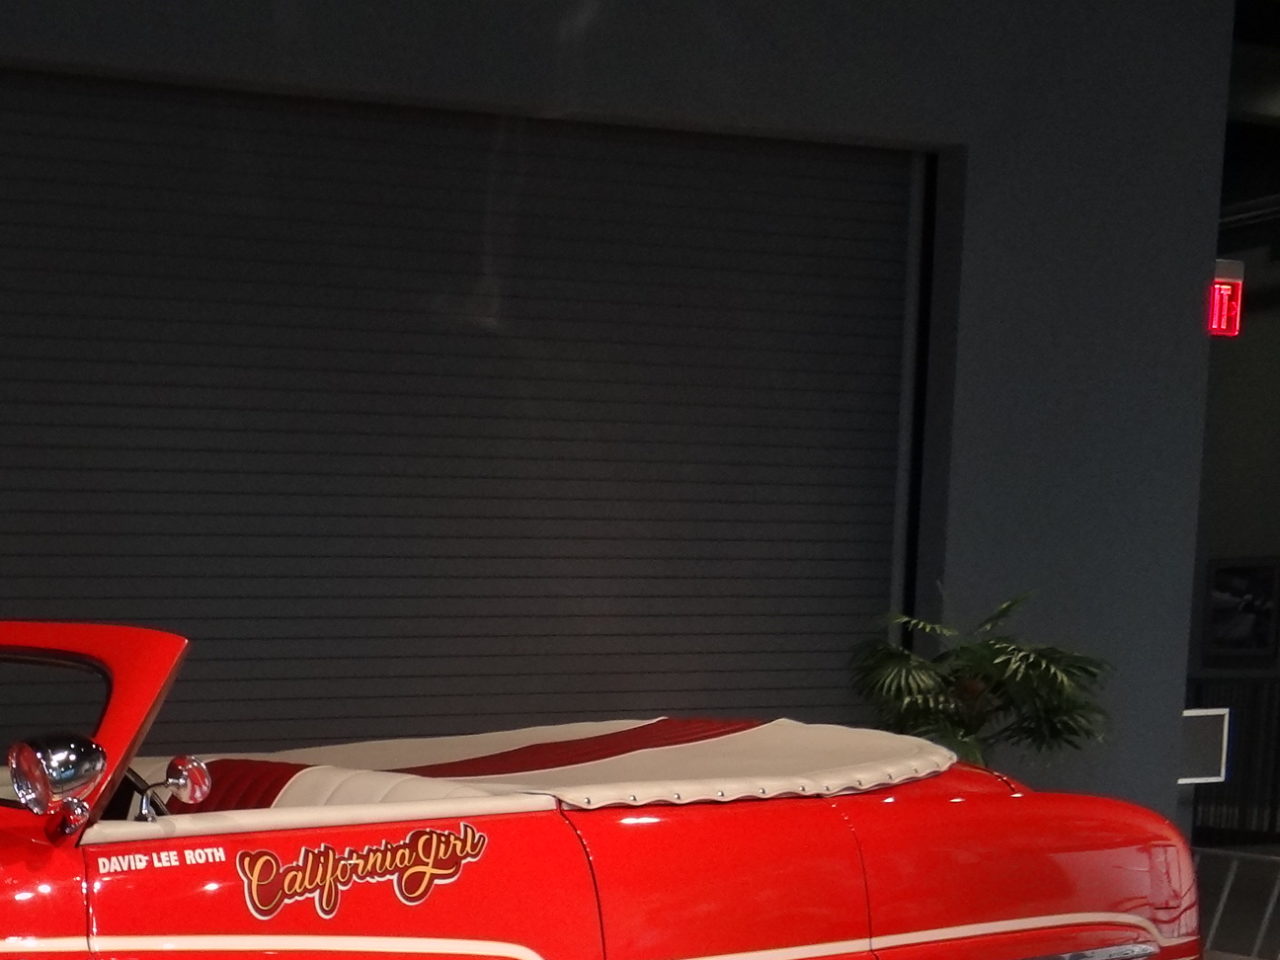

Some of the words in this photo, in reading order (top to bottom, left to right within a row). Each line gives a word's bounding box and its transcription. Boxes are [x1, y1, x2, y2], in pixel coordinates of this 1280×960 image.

[98, 849, 147, 874] DAVID
[153, 850, 179, 868] LEE
[185, 847, 226, 865] ROTH
[238, 844, 417, 919] California
